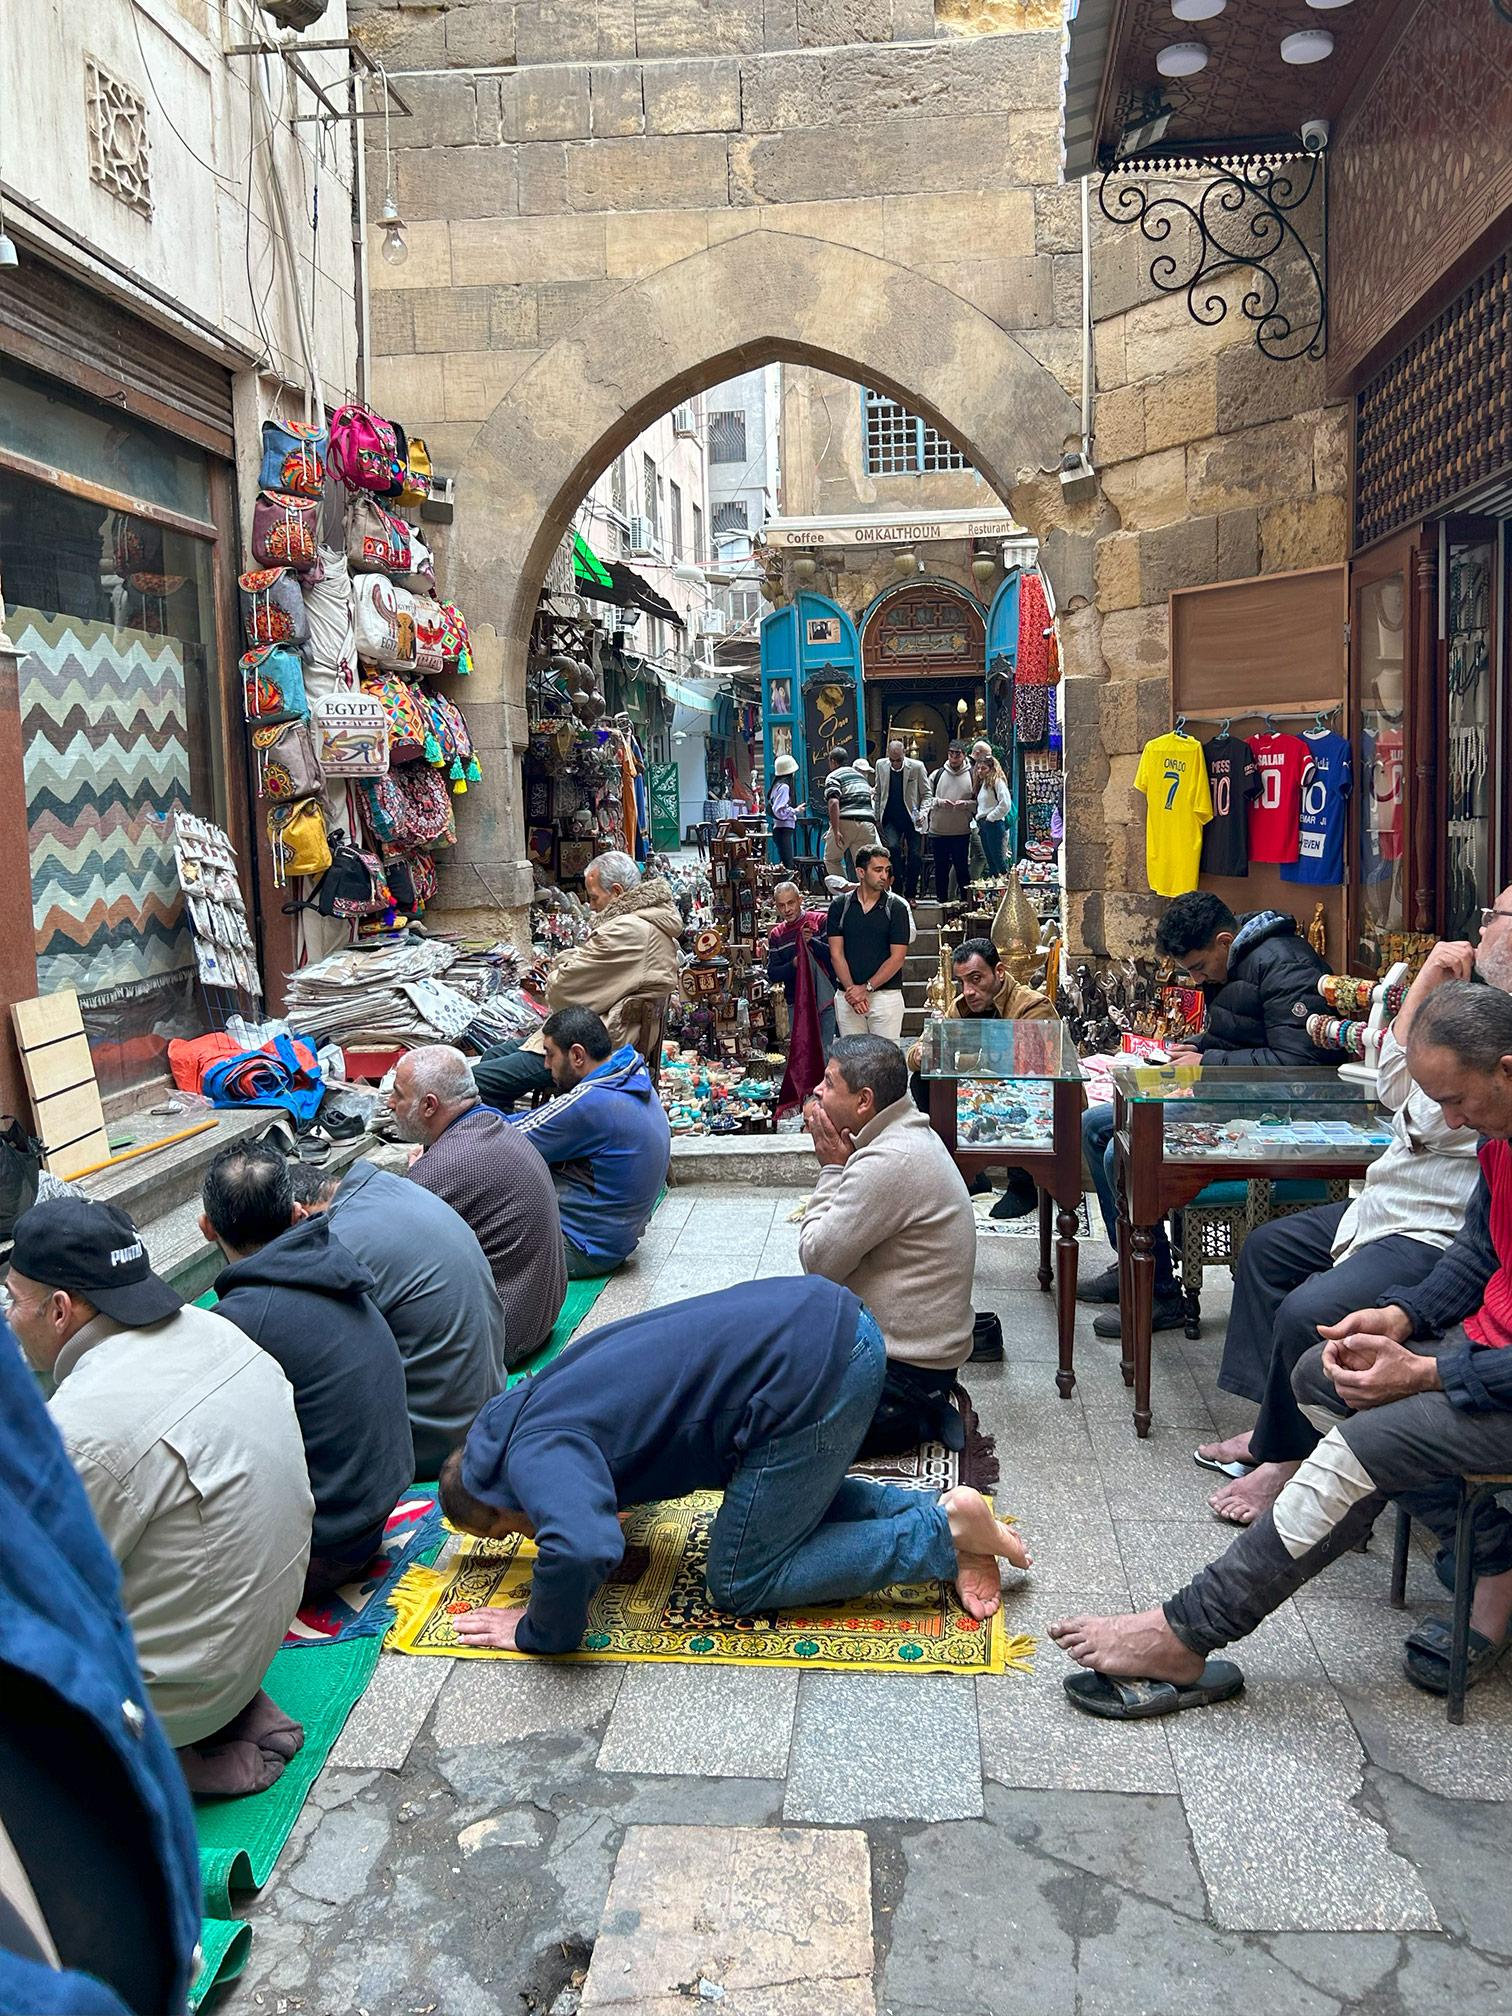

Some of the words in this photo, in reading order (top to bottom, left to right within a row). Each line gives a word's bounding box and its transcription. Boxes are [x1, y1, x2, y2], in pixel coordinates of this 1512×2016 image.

[786, 532, 824, 544] Coffee
[855, 526, 941, 541] OMKALTHOUM
[968, 523, 1010, 536] Resturant
[325, 703, 378, 715] EGYPT
[1164, 772, 1180, 810] 7
[1211, 776, 1231, 816] 10
[1301, 781, 1327, 815] 10
